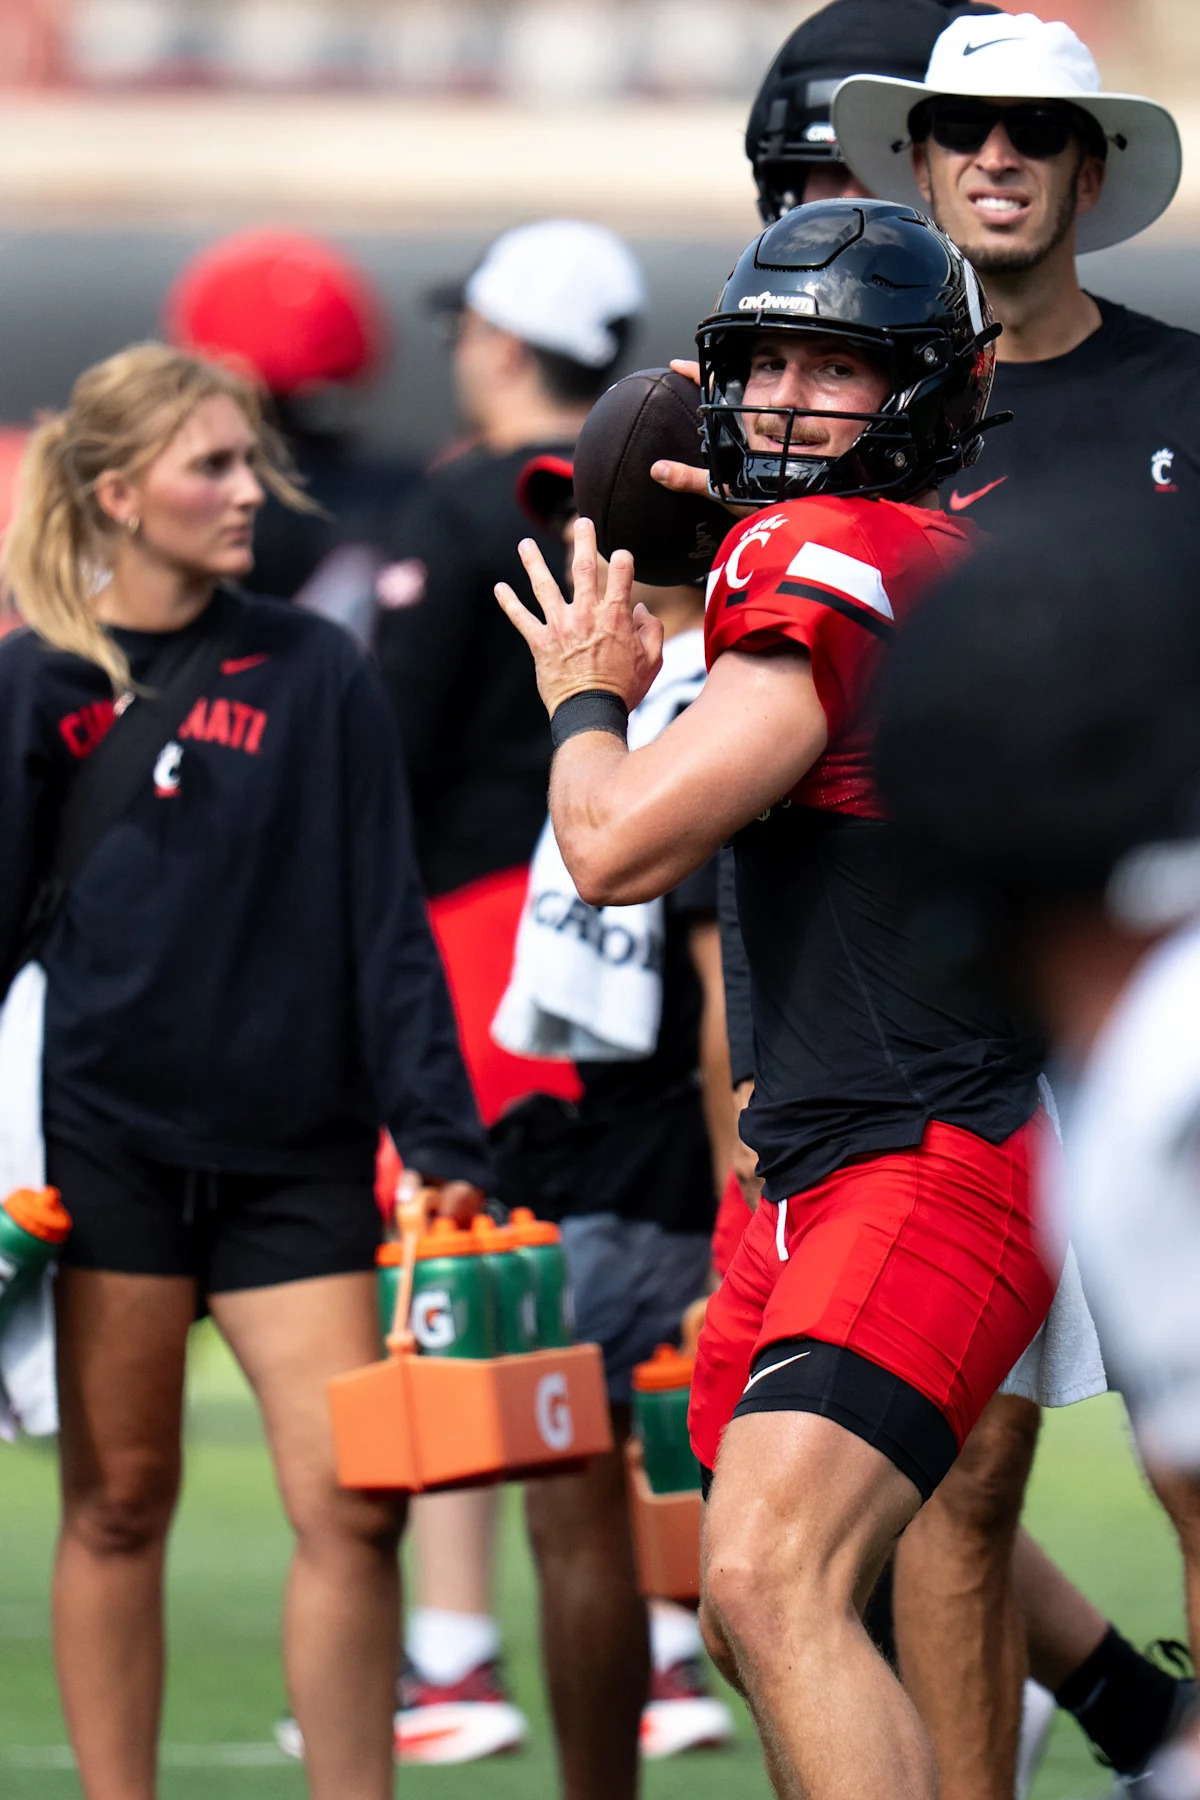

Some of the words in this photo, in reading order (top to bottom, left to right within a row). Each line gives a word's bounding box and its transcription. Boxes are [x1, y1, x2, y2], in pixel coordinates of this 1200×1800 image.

[1151, 455, 1173, 485] C
[411, 1289, 456, 1349] G
[533, 1371, 574, 1451] G
